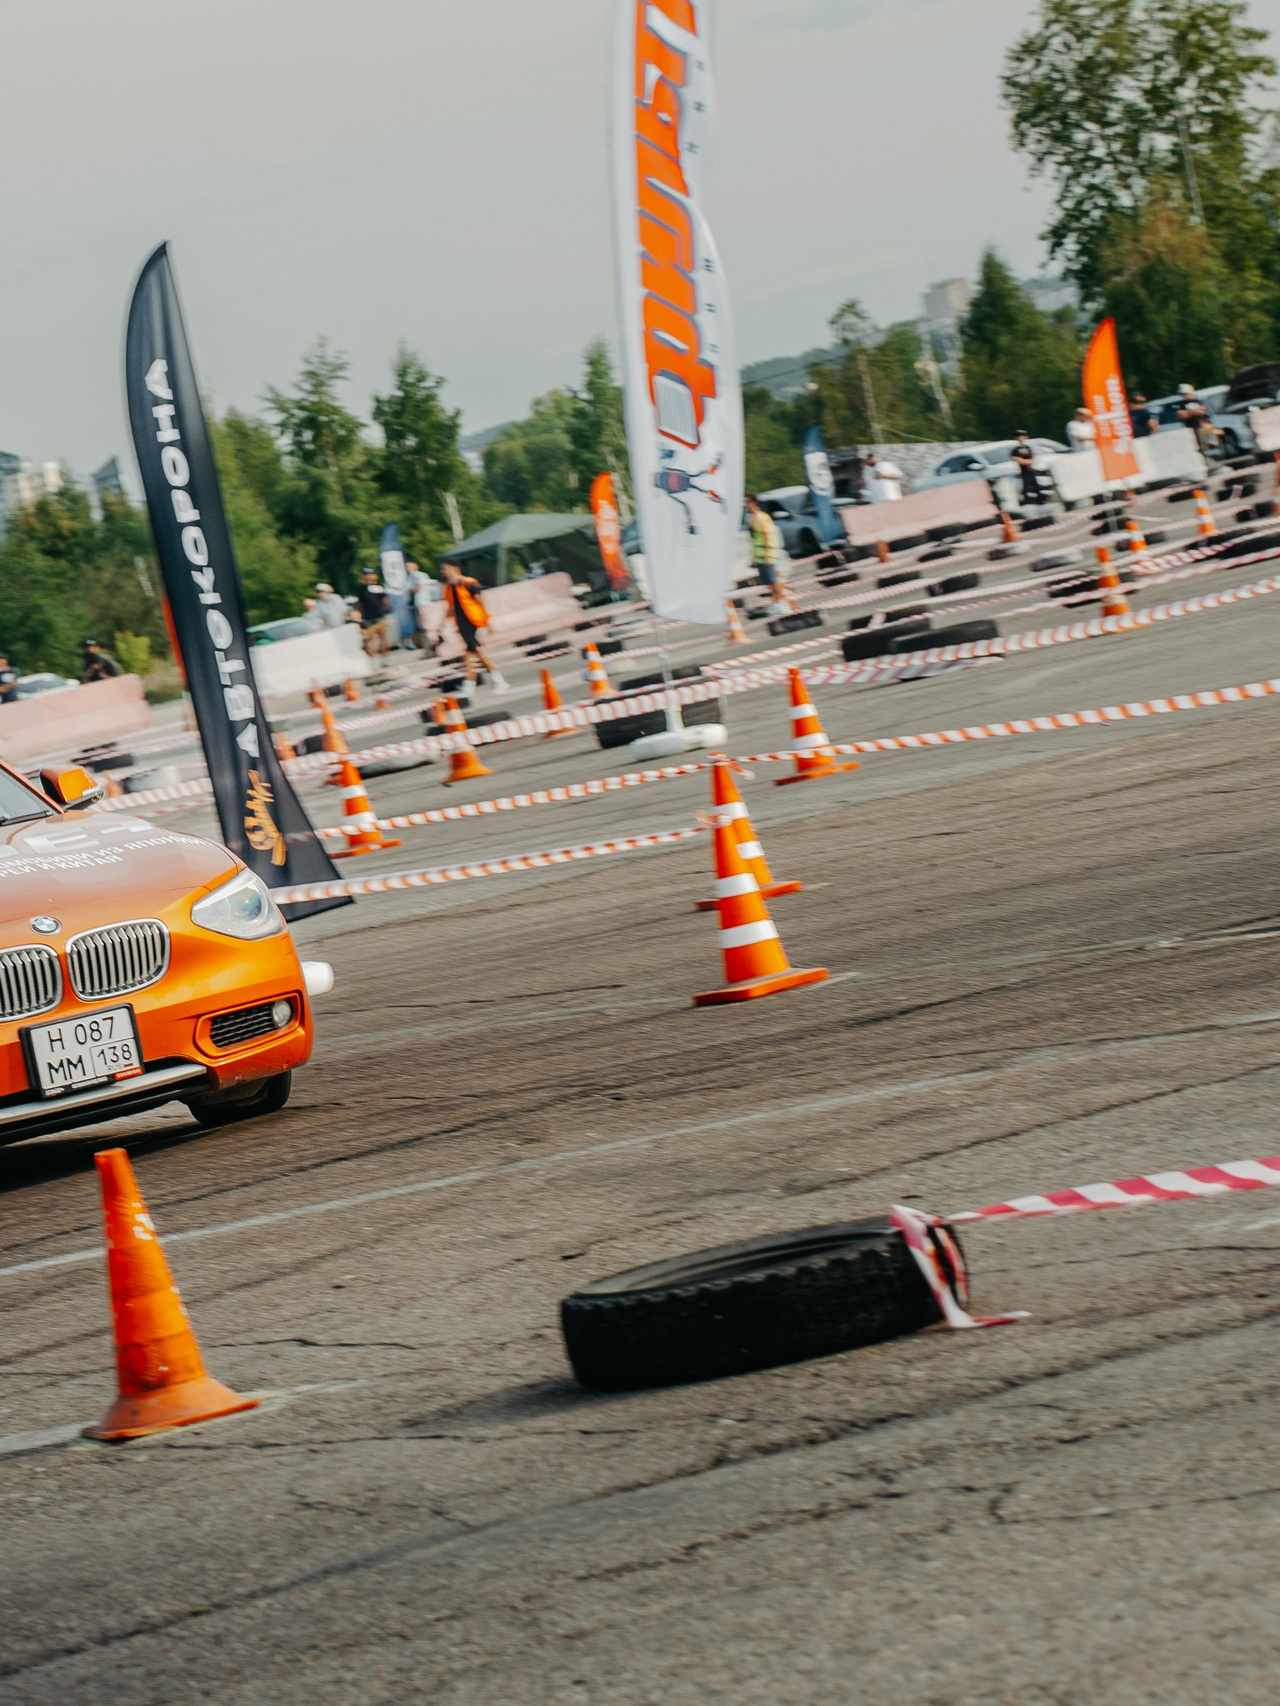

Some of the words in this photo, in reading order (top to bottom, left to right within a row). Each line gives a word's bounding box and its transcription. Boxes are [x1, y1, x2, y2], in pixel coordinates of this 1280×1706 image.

[144, 357, 261, 758] АВТОКОРОНА
[74, 1015, 115, 1046] 087
[96, 1043, 133, 1066] 138
